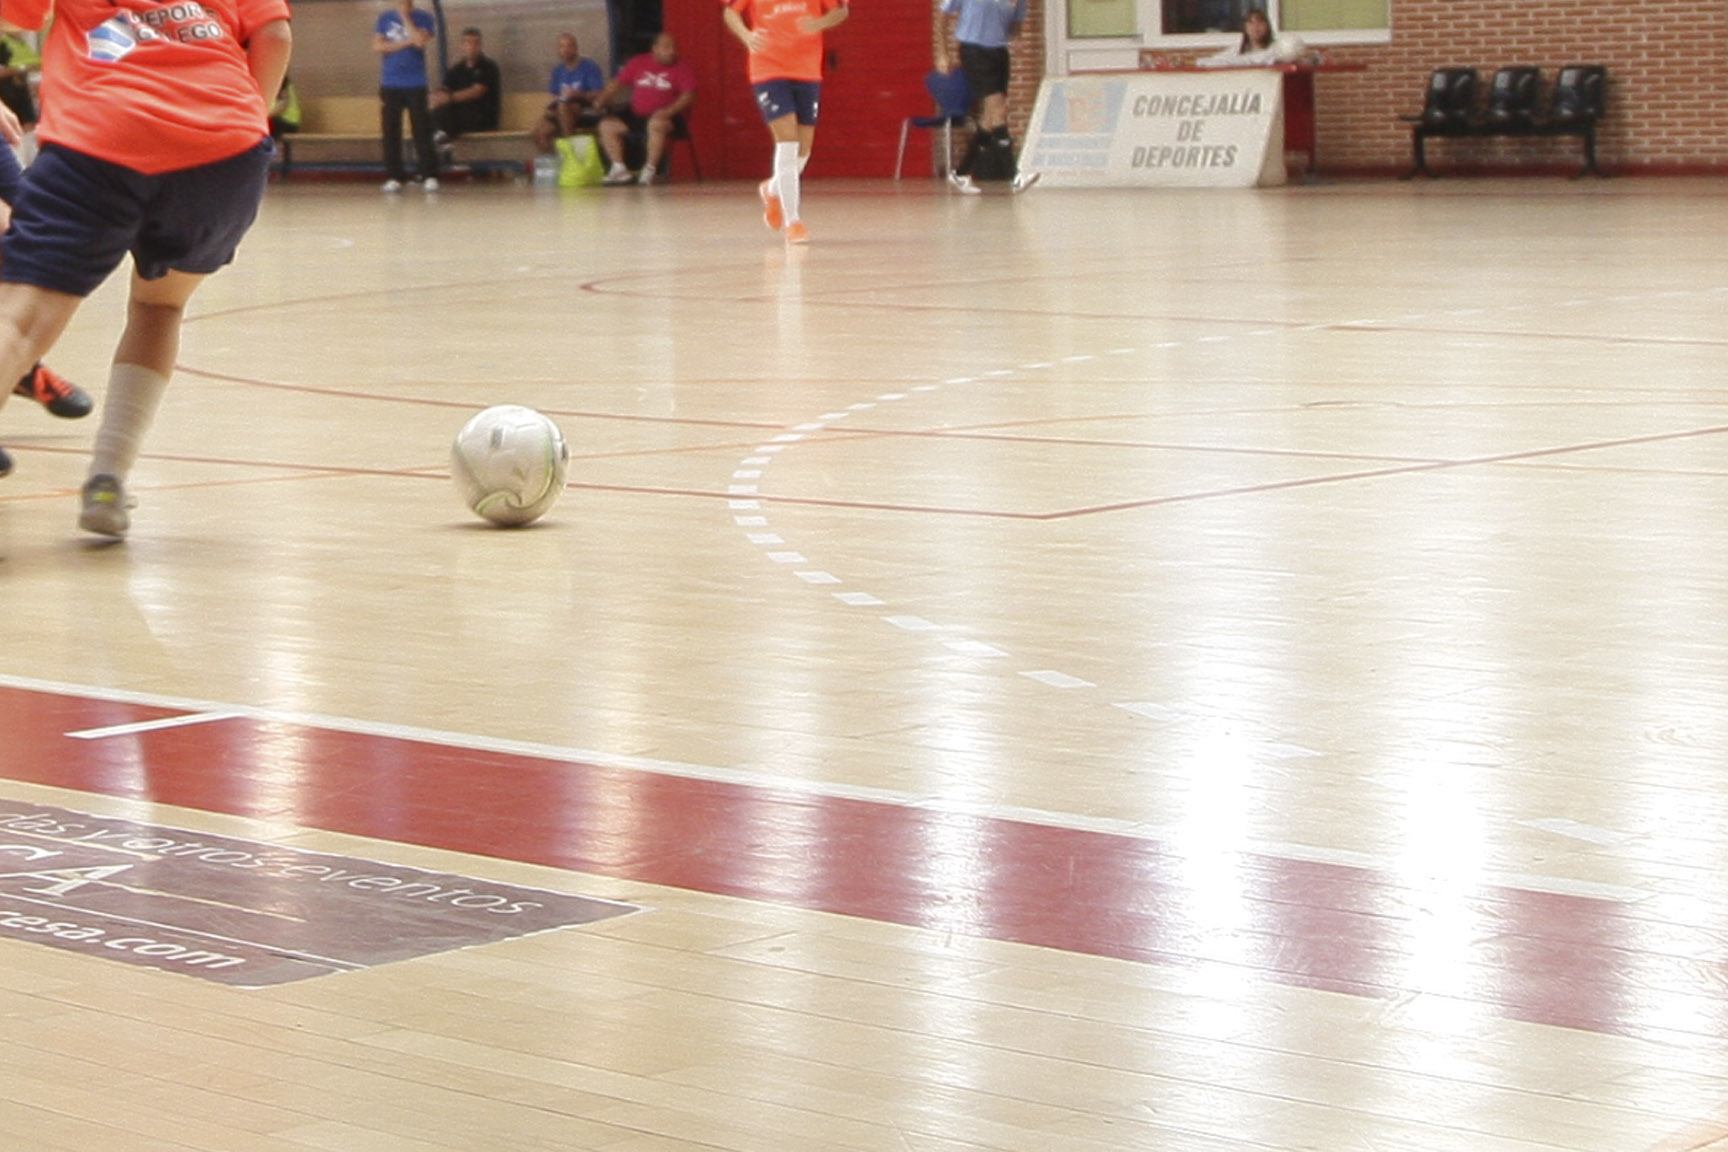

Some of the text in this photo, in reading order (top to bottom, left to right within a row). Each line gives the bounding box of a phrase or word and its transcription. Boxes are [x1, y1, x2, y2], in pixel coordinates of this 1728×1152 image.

[1133, 91, 1262, 117] CONCEJALÍA
[1177, 119, 1206, 142] DE
[1131, 144, 1238, 168] DEPORTES
[284, 860, 544, 916] eventos
